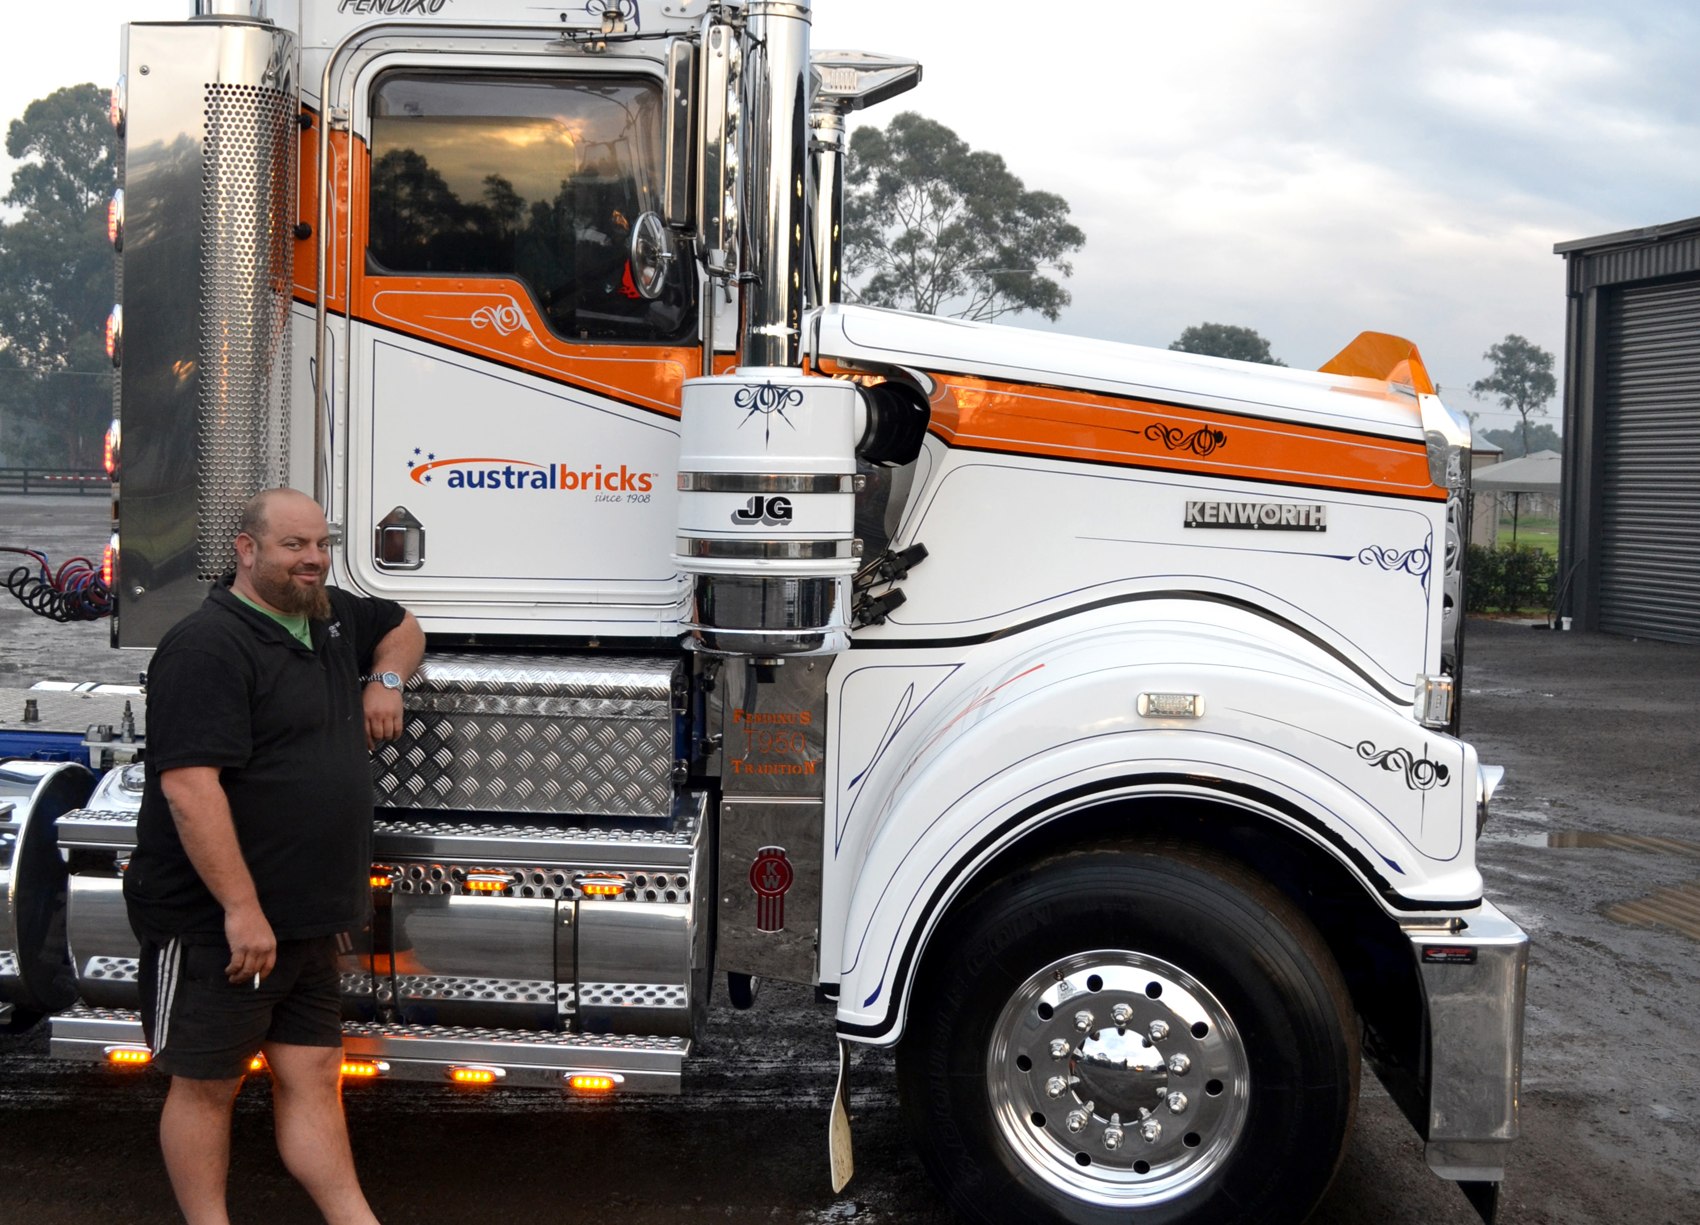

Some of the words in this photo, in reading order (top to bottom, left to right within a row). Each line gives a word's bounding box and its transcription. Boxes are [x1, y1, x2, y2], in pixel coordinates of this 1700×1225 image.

[447, 464, 653, 491] australbricks
[594, 492, 623, 503] since
[626, 493, 652, 503] 1908
[731, 496, 793, 526] JG
[1185, 501, 1327, 526] KENWORTH
[742, 728, 806, 754] T950
[731, 759, 817, 776] TRADITION
